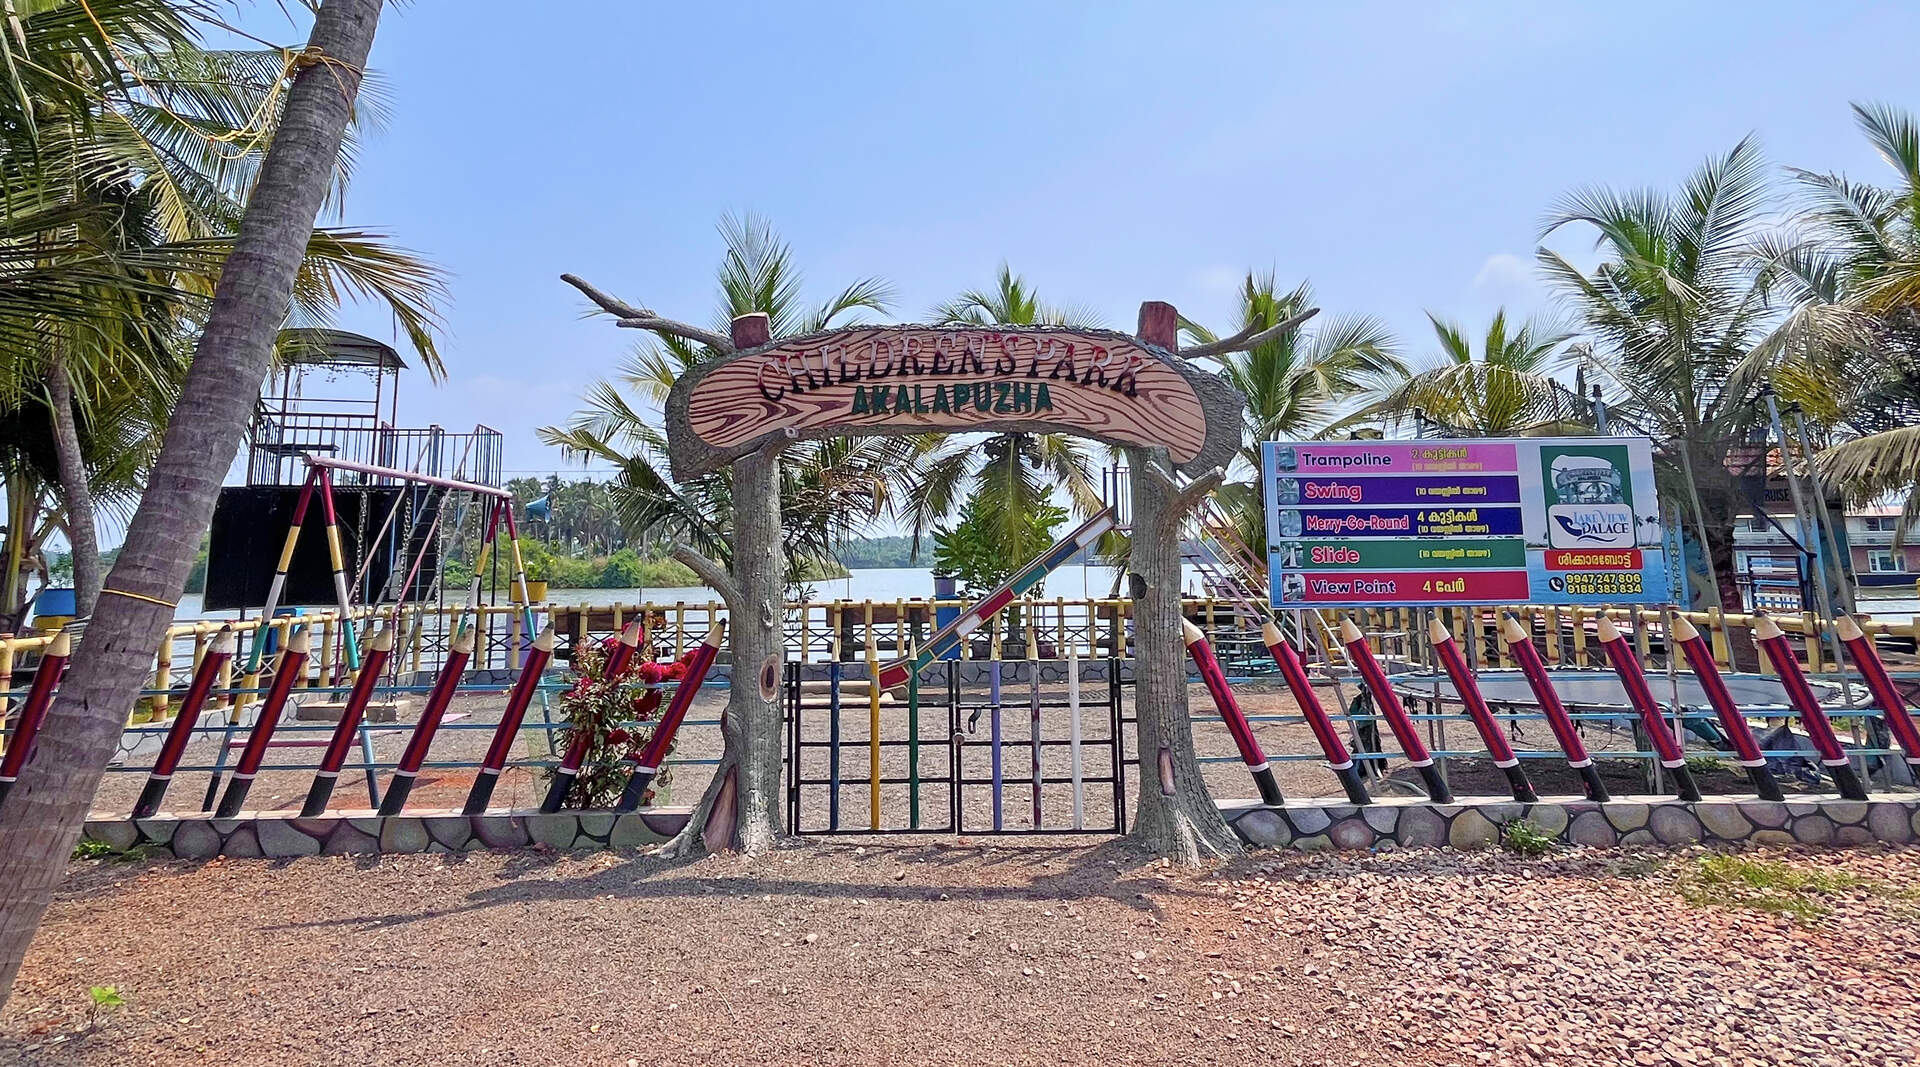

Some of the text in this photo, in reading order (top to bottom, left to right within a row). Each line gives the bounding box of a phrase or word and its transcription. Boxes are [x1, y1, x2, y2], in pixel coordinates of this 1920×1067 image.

[757, 333, 1156, 401] CHILDREN'S PARK
[851, 382, 1053, 415] AKALAPUZHA
[1302, 452, 1392, 469] Trampoline
[1305, 482, 1362, 502] Swing
[1306, 515, 1409, 533] Merry-Go-Round
[1417, 511, 1425, 522] 4
[1573, 510, 1628, 528] LAKE VIEW
[1582, 522, 1629, 535] PALACE
[1311, 546, 1360, 563] Slide
[1311, 579, 1397, 594] View Point
[1422, 580, 1431, 592] 4
[1566, 574, 1641, 583] 9947 247 806
[1567, 584, 1642, 594] 9188 383 834
